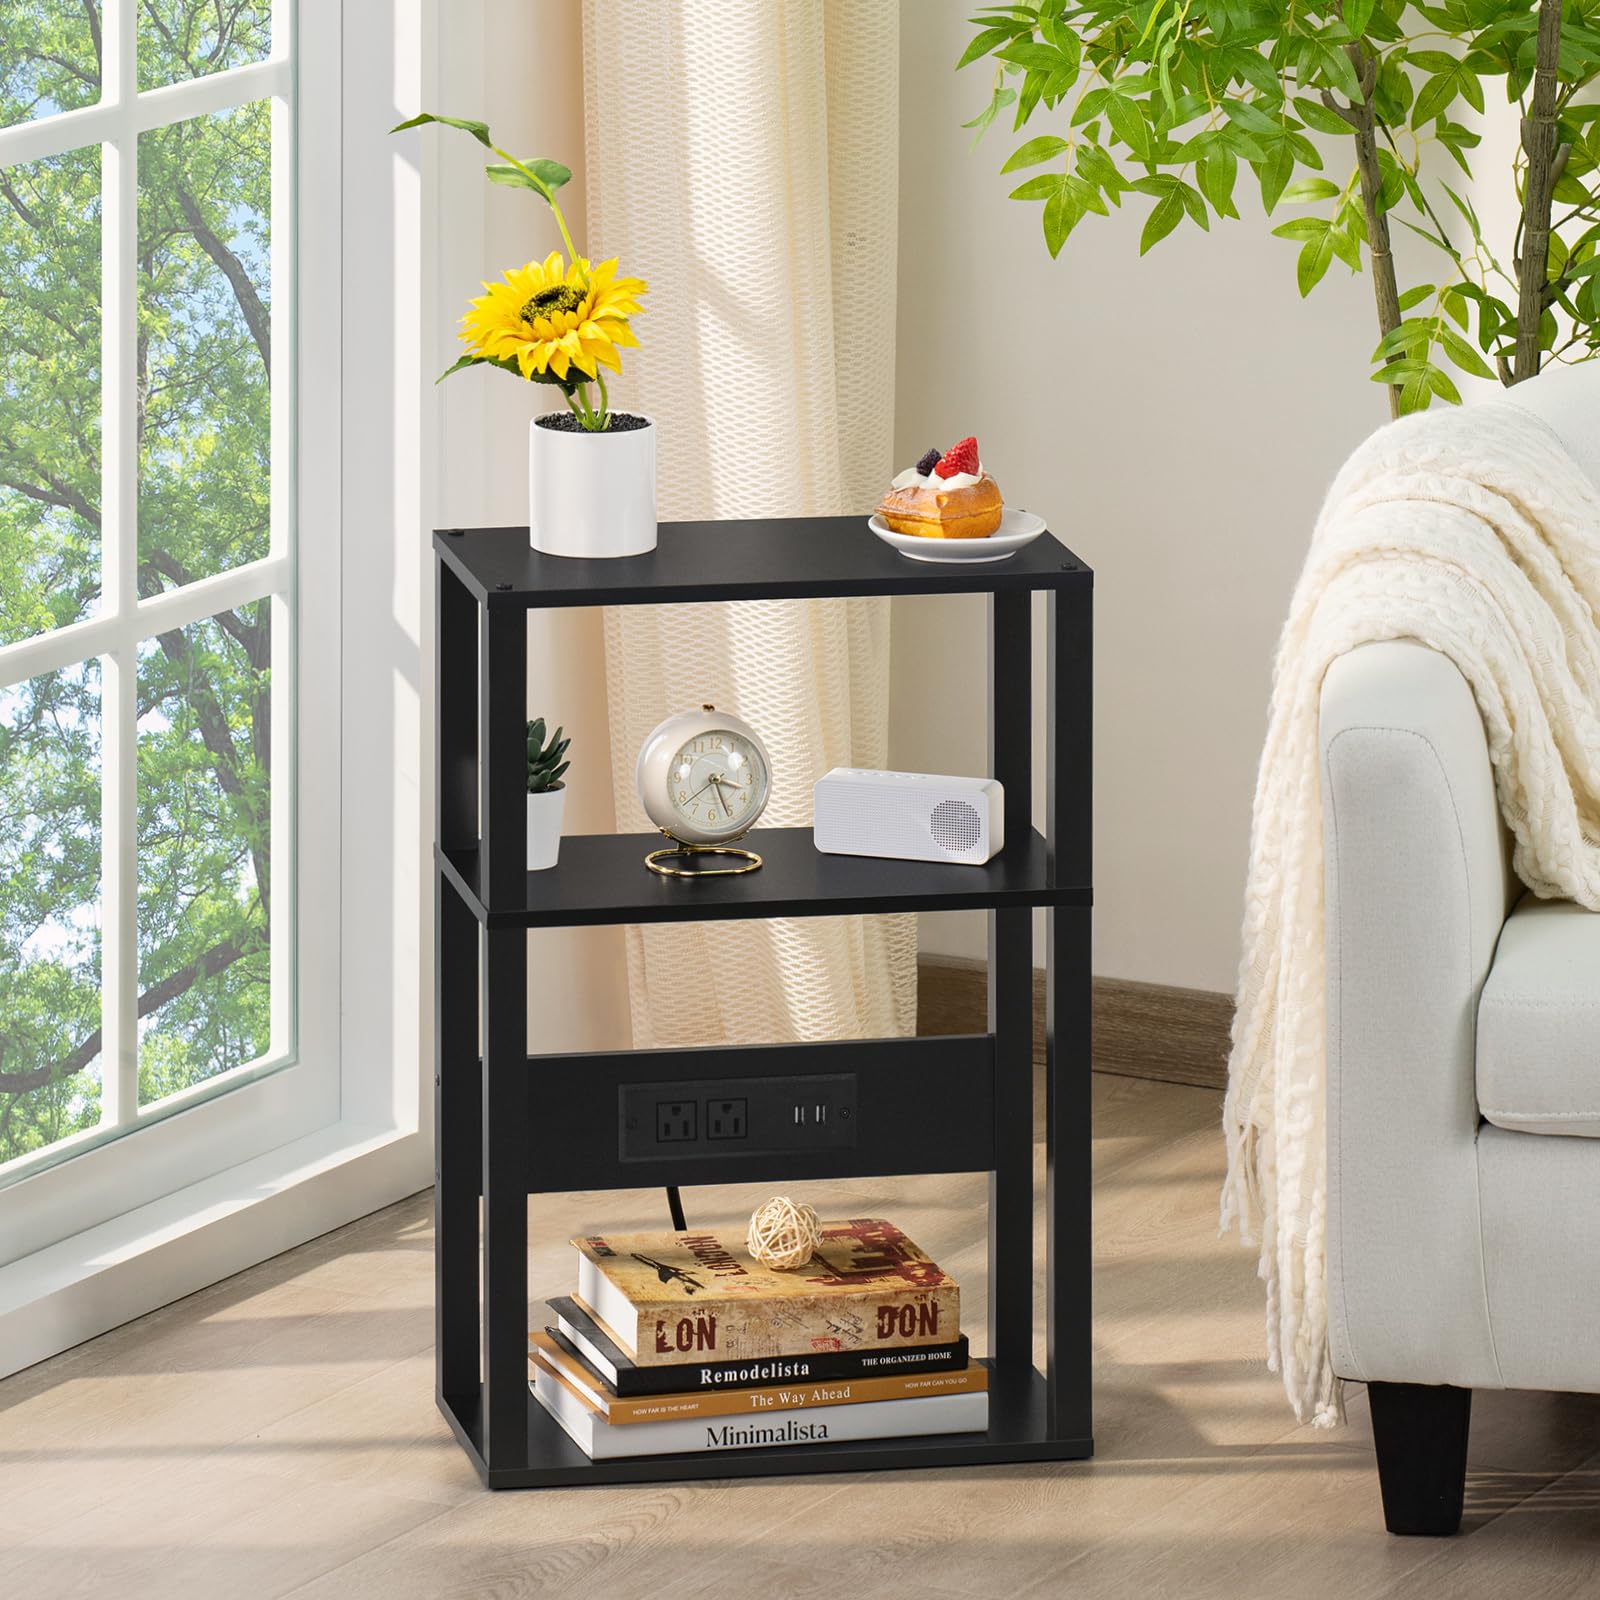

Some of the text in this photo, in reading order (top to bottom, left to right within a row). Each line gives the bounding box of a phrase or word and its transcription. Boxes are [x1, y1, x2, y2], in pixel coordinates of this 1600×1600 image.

[692, 741, 705, 753] 11
[709, 737, 723, 750] 12
[730, 742, 735, 753] 1
[677, 753, 693, 765] 10
[741, 755, 749, 767] 2
[673, 771, 682, 784] 9
[746, 773, 753, 785] 3
[678, 790, 687, 801] 8
[739, 792, 747, 803] 4
[692, 803, 699, 815] 7
[707, 808, 716, 820] 6
[727, 804, 734, 816] 5
[655, 1314, 718, 1353] LON
[876, 1299, 938, 1339] DON
[861, 1351, 952, 1367] THE ORGANIZED HOME
[700, 1362, 810, 1385] Remodelista
[750, 1387, 851, 1407] The Way Ahead
[632, 1408, 648, 1416] HOW
[679, 1403, 699, 1411] HEART
[706, 1420, 829, 1448] Minimalista
